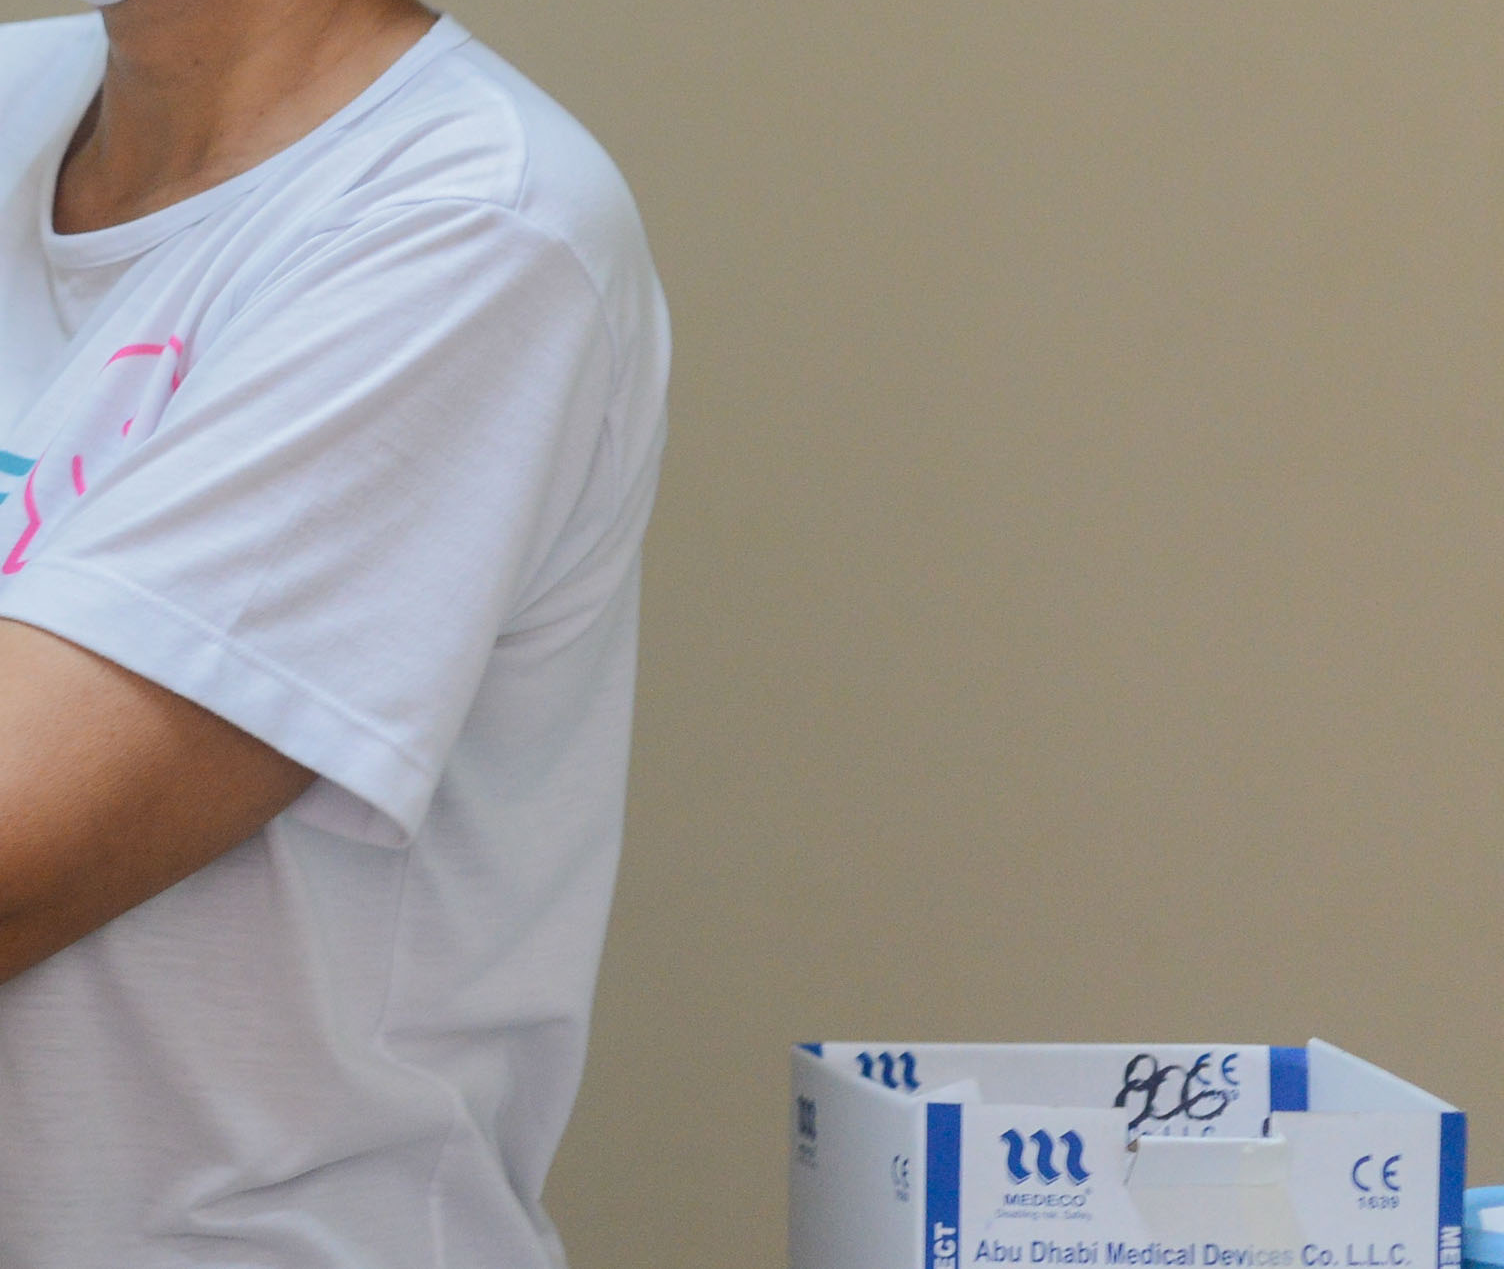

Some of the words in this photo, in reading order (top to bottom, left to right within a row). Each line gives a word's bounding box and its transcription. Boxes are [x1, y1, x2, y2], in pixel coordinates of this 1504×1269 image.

[1352, 1154, 1402, 1191] CE
[1004, 1193, 1086, 1207] MEDECO
[974, 1239, 1022, 1264] Abu
[1029, 1239, 1099, 1265] Dhabi
[1106, 1241, 1195, 1266] Medical
[1202, 1242, 1292, 1267] Devices
[1301, 1243, 1339, 1267] Co.
[1346, 1243, 1413, 1268] L.L.C.
